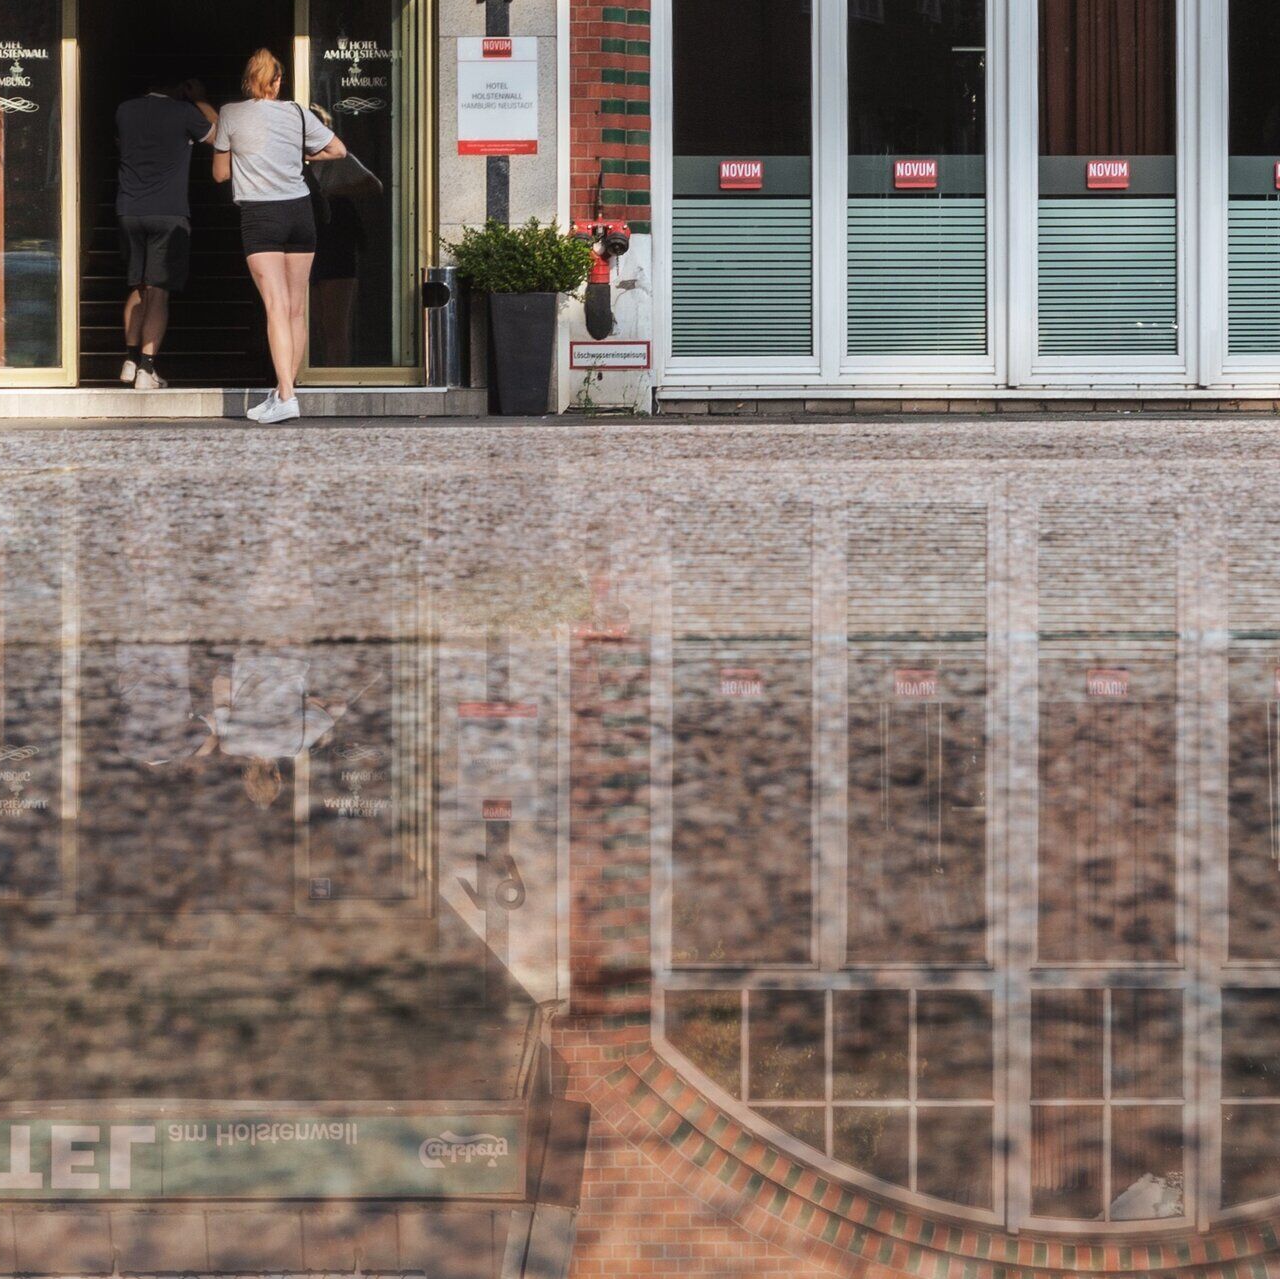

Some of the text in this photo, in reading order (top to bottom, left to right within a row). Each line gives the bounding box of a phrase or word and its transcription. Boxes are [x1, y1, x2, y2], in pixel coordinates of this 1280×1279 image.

[349, 40, 378, 50] HOTEL
[483, 40, 511, 50] NOVUM
[323, 49, 340, 59] AM
[341, 76, 387, 87] HAMBURG
[486, 82, 508, 90] HOTEL
[471, 92, 522, 100] HOLSTENWALL
[721, 162, 762, 177] NOVUM
[896, 162, 936, 177] NOVUM
[1089, 162, 1128, 177] NOVUM
